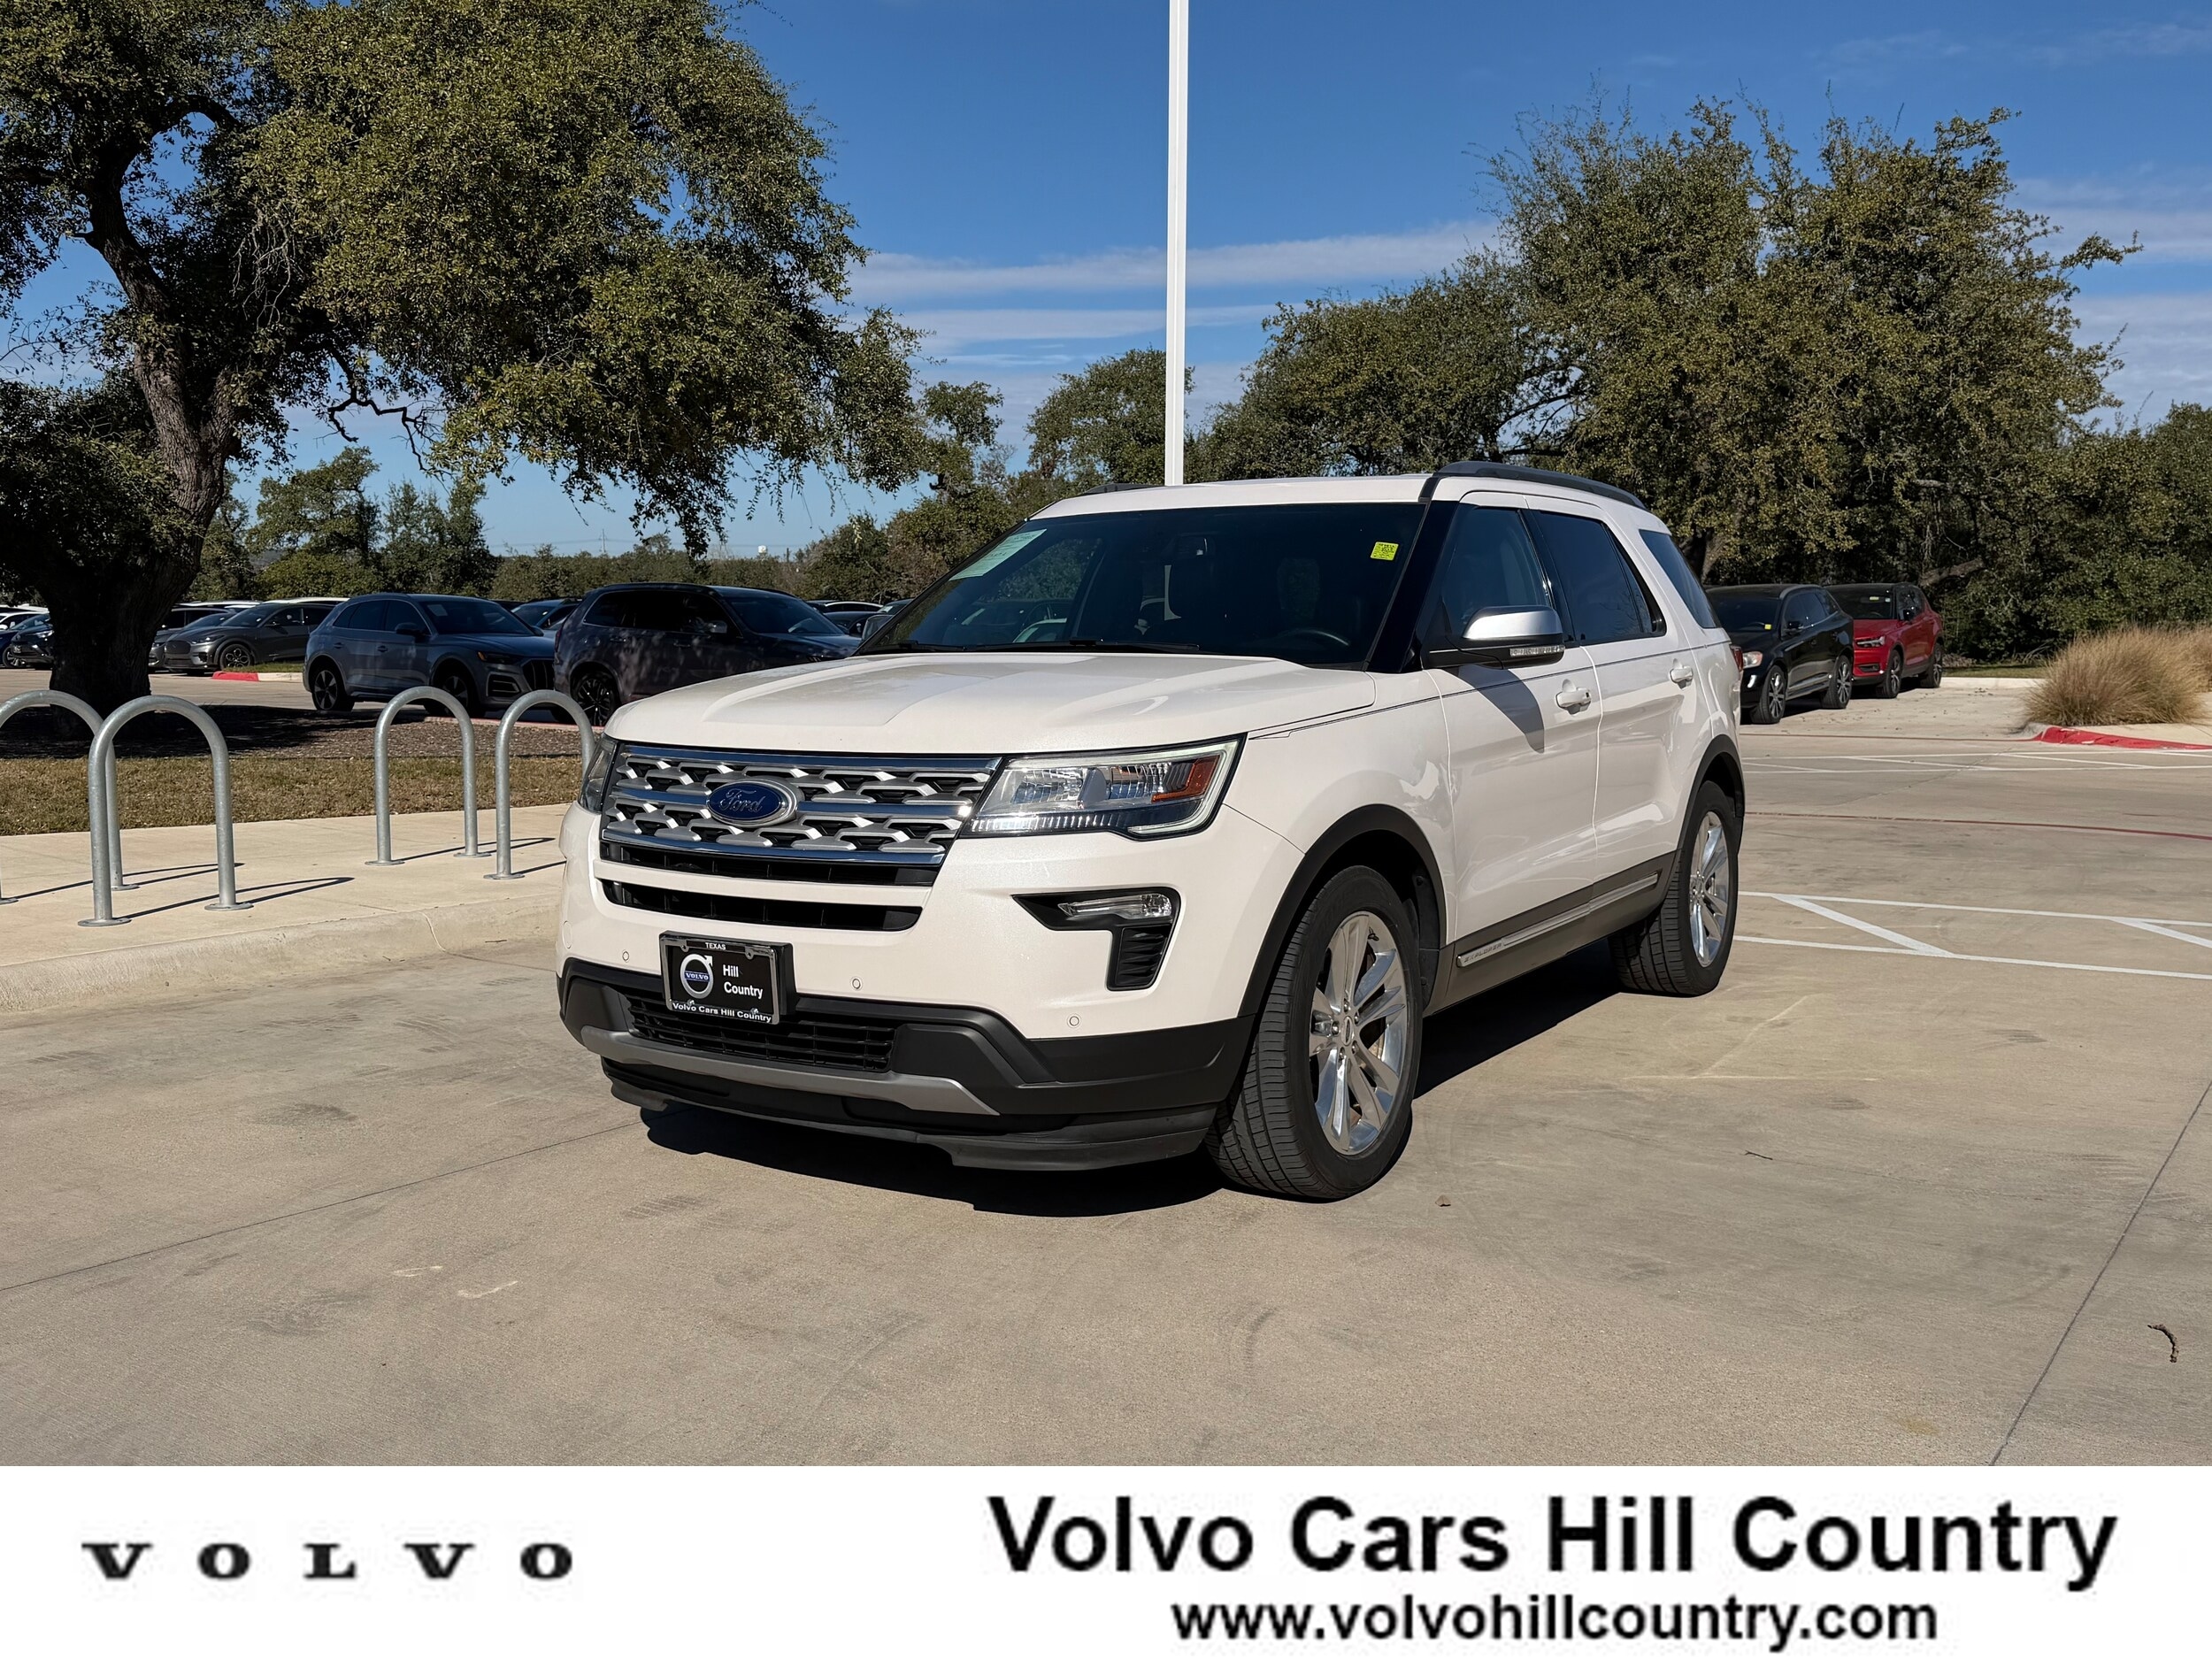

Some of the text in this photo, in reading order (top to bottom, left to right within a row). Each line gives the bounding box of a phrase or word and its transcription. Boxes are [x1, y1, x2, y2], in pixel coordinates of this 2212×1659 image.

[718, 787, 766, 813] Ford
[685, 972, 710, 981] VOLVO
[722, 964, 739, 978] Hill
[724, 981, 764, 1000] Country
[672, 1002, 696, 1011] Volvo
[699, 1005, 718, 1015] Cars
[736, 1010, 772, 1023] Country
